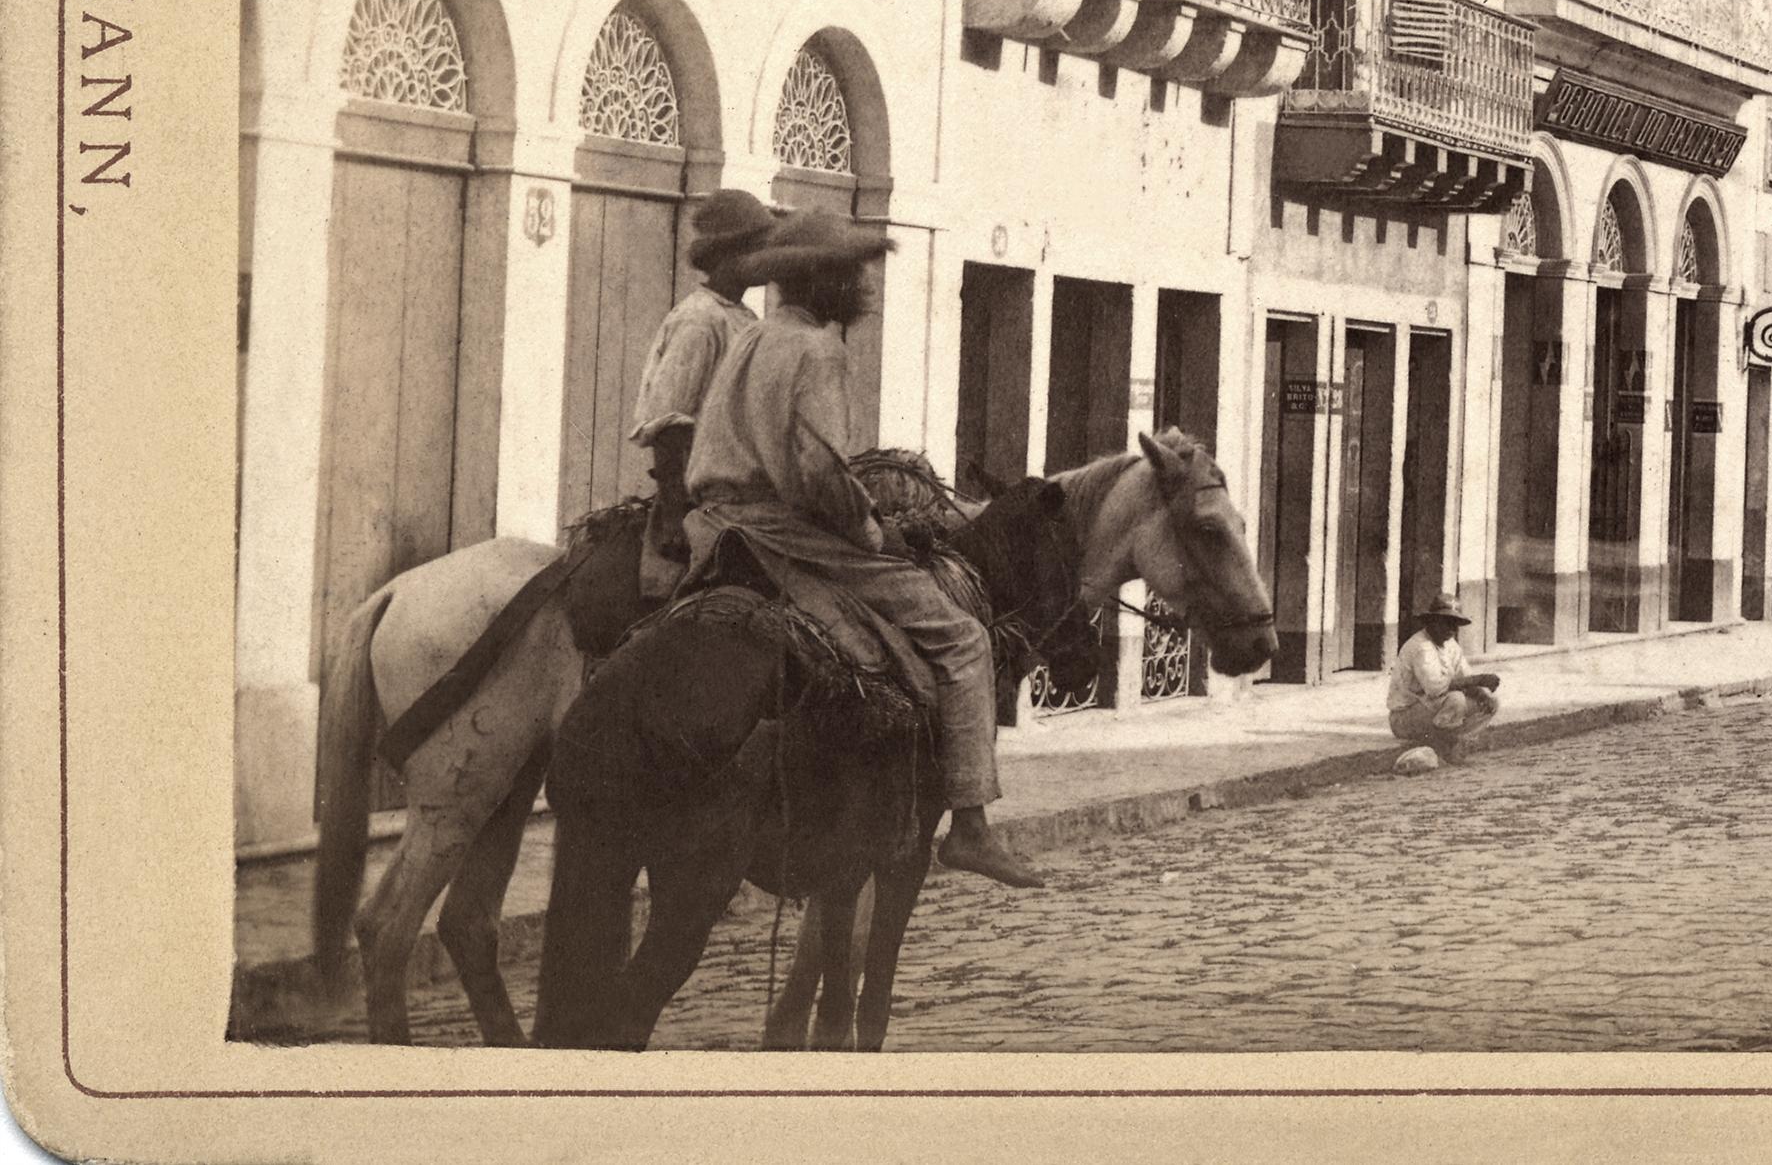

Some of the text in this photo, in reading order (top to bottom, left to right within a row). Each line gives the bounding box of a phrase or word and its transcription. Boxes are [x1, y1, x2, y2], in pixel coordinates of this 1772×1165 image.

[1571, 90, 1641, 141] BOTICA
[1636, 108, 1667, 148] DO
[1660, 117, 1725, 164] RECIFE
